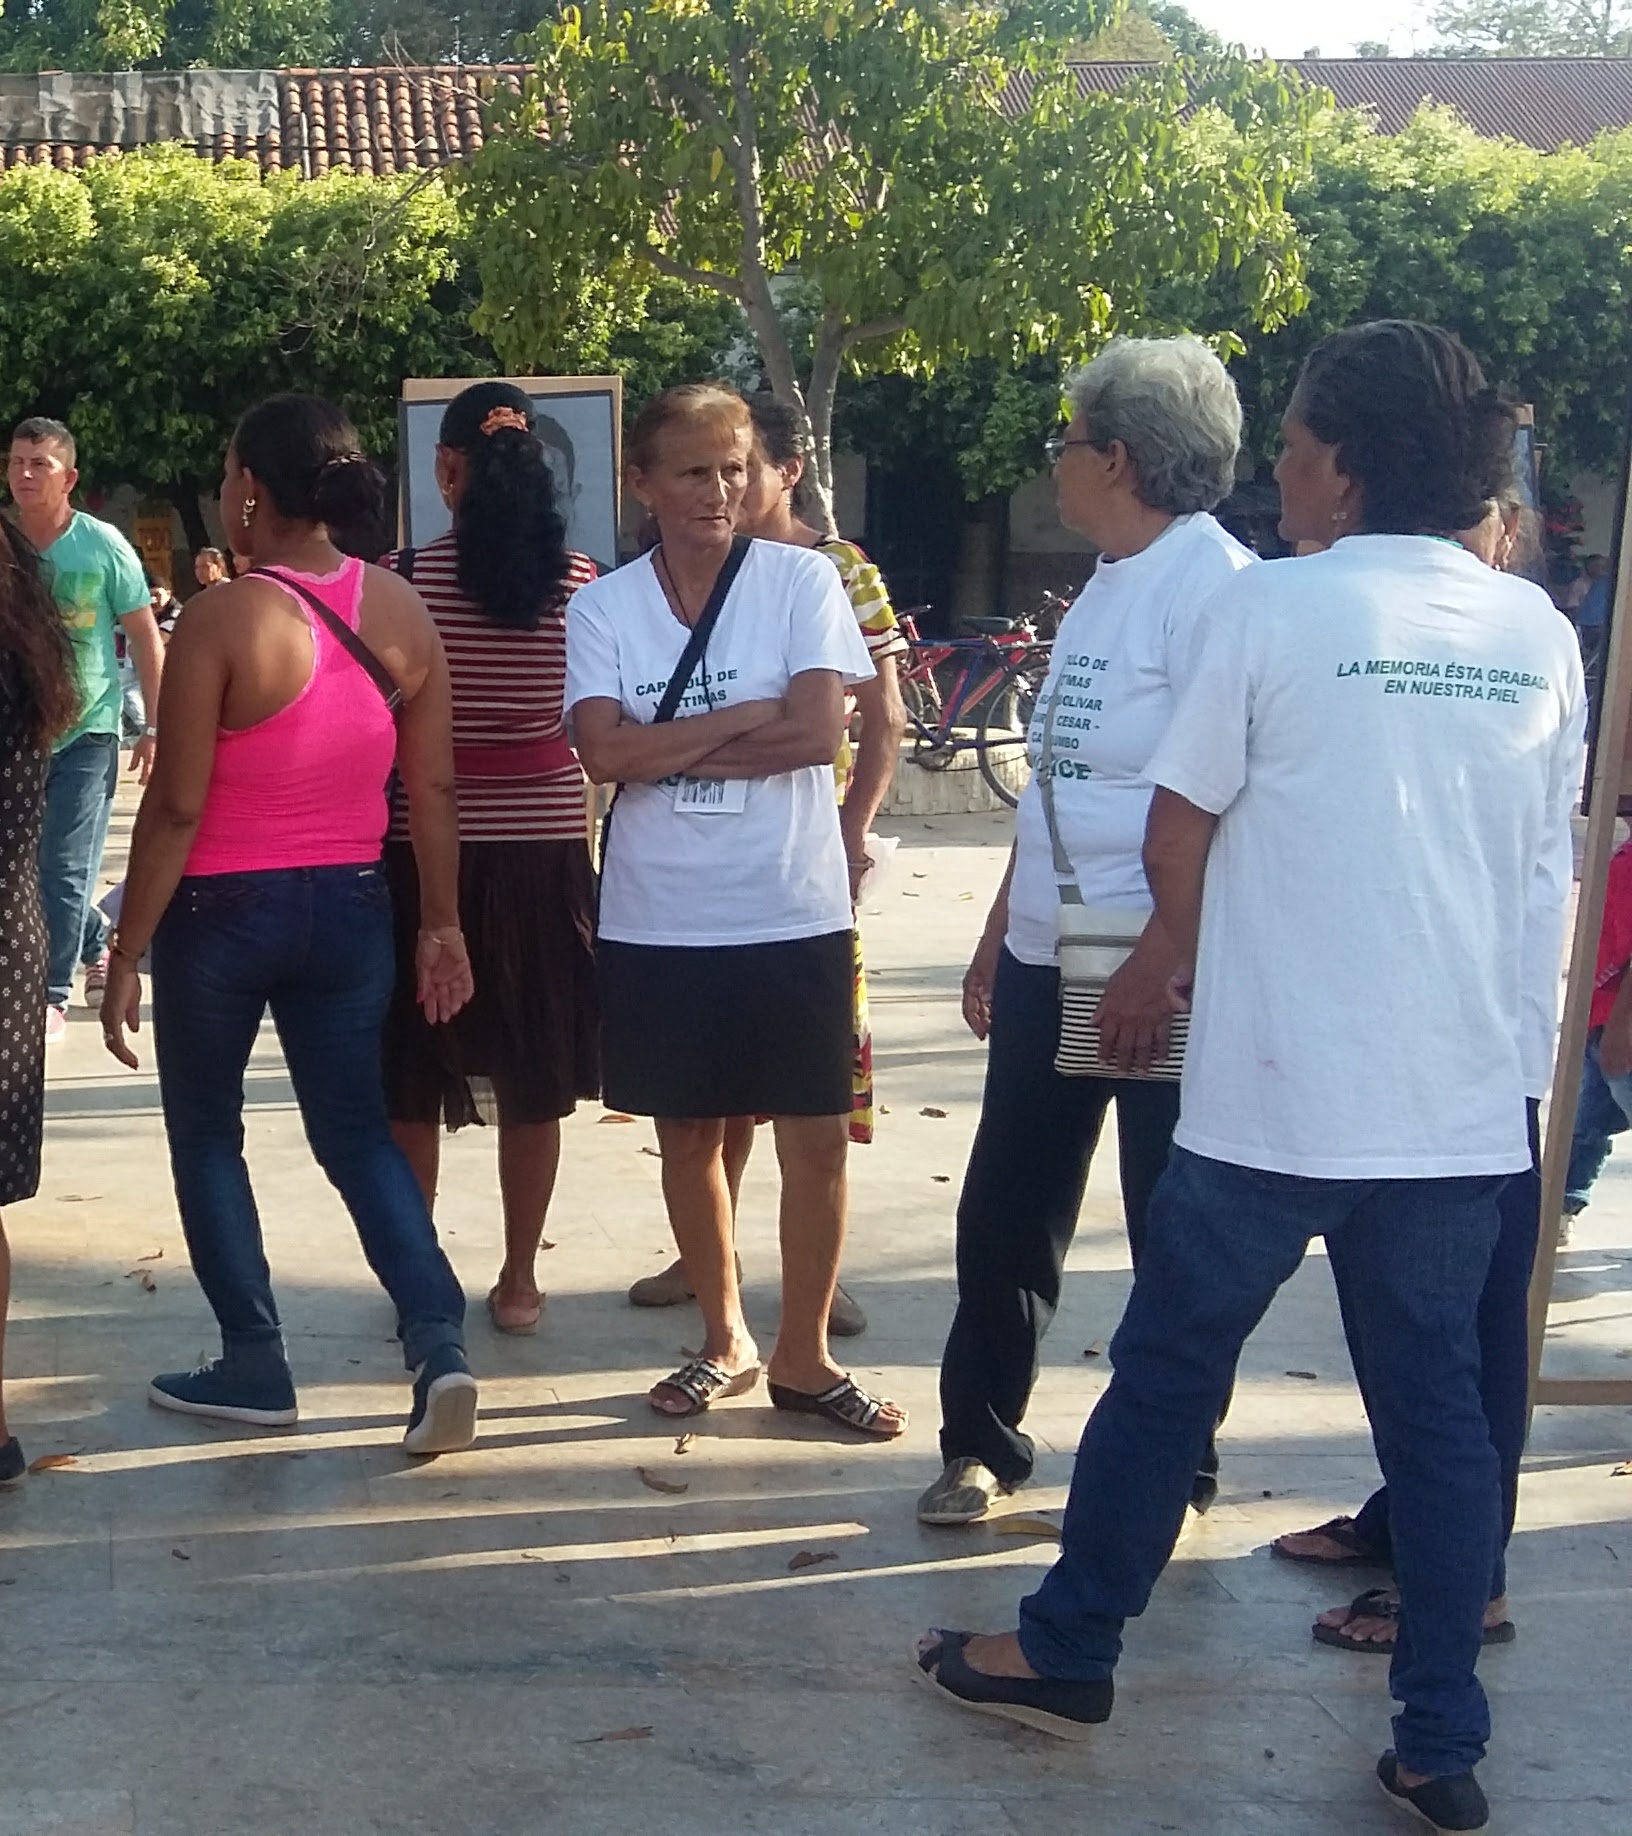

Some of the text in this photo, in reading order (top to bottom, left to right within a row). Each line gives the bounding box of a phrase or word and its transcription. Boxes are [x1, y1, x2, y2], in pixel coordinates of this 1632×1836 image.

[1092, 658, 1109, 671] DE
[1337, 661, 1360, 678] LA
[1365, 660, 1440, 677] MEMORIA
[717, 669, 738, 682] DE
[1384, 680, 1520, 704] EN NUESTRA PIEL
[1056, 715, 1092, 731] CESAR
